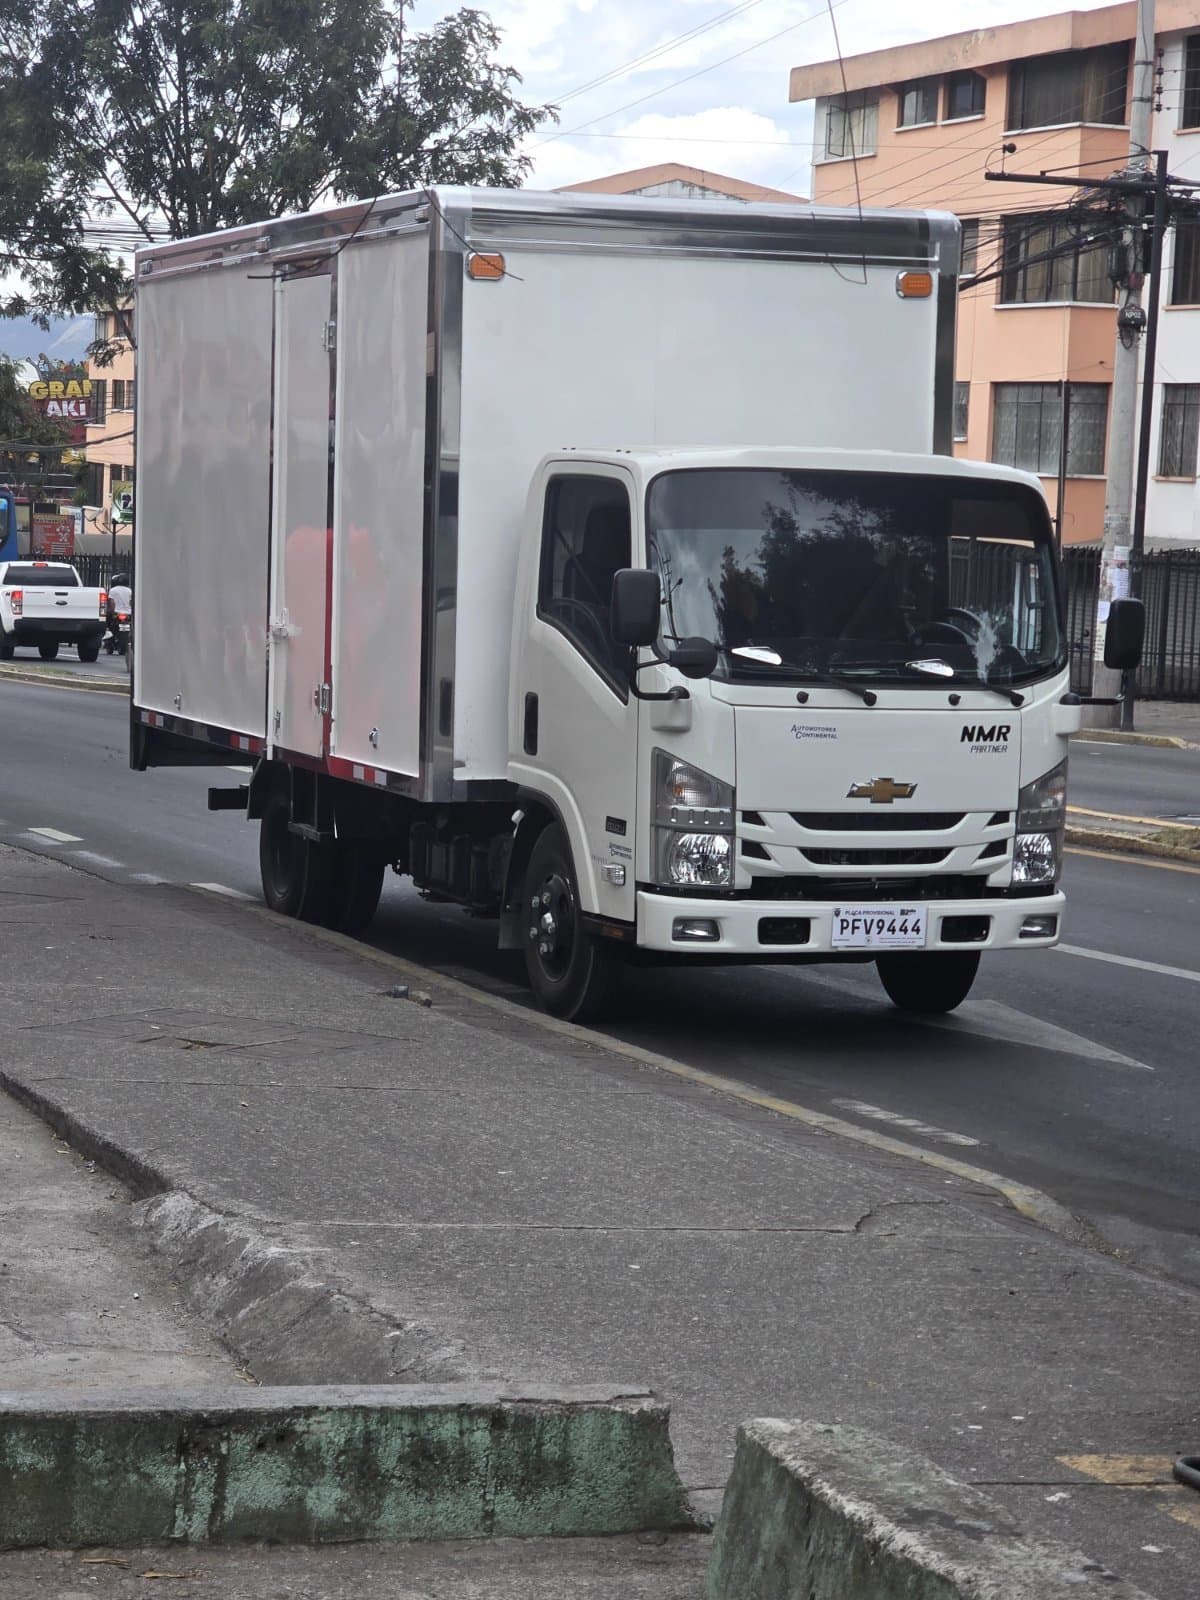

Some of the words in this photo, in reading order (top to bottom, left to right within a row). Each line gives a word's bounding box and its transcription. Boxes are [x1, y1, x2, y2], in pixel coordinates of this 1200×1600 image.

[960, 725, 1011, 742] NMR
[970, 744, 1008, 753] PARTNER
[840, 918, 921, 935] PFV9444
